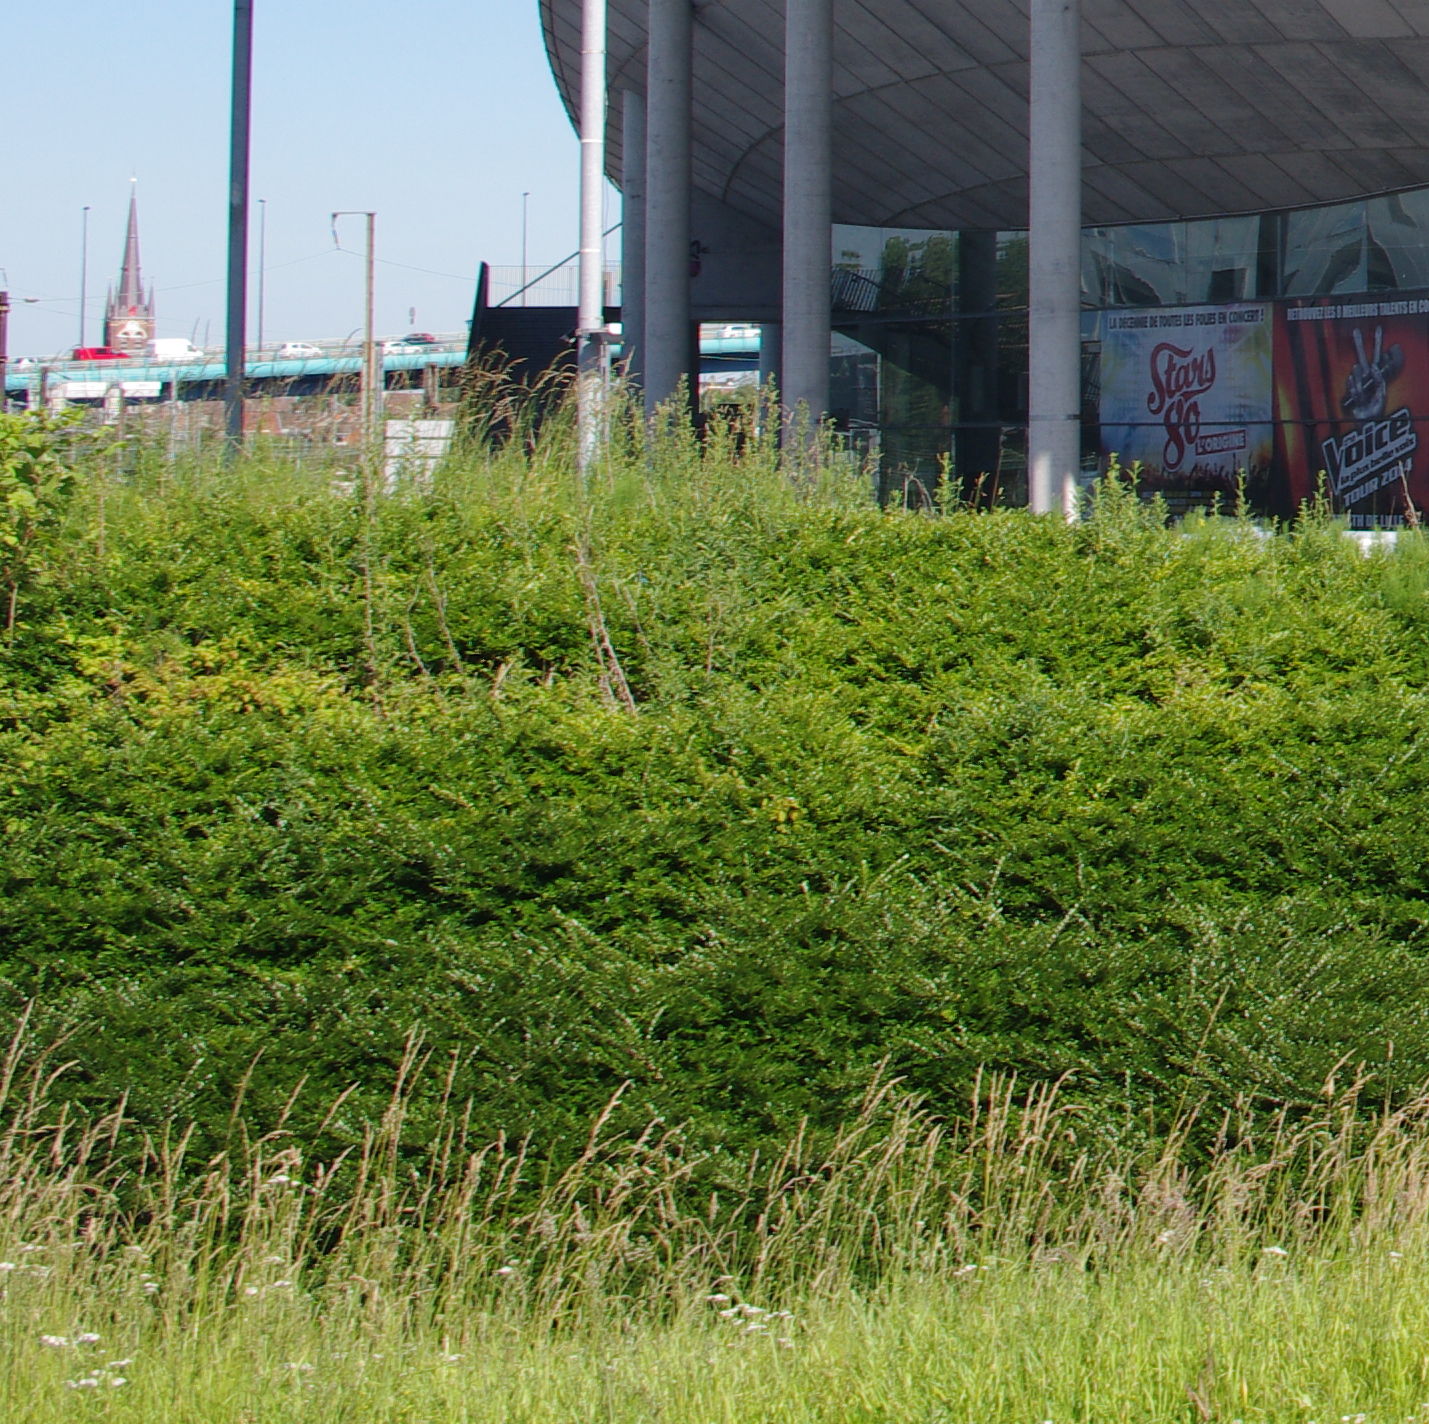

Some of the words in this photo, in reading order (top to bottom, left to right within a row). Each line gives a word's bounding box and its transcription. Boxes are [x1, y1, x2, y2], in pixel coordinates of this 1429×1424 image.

[1109, 316, 1117, 330] LA
[1149, 315, 1158, 328] DE
[1159, 313, 1182, 327] TOUTES
[1183, 313, 1194, 326] LES
[1195, 312, 1217, 326] FOLIES
[1218, 311, 1227, 324] EN
[1228, 309, 1260, 324] CONCERT
[1324, 306, 1336, 319] LES
[1379, 301, 1408, 316] TALENTS
[1408, 300, 1418, 314] EN
[1147, 342, 1216, 414] Stars
[1163, 398, 1200, 470] 80
[1197, 432, 1246, 453] L'ORIGINE
[1343, 477, 1379, 507] TOUR
